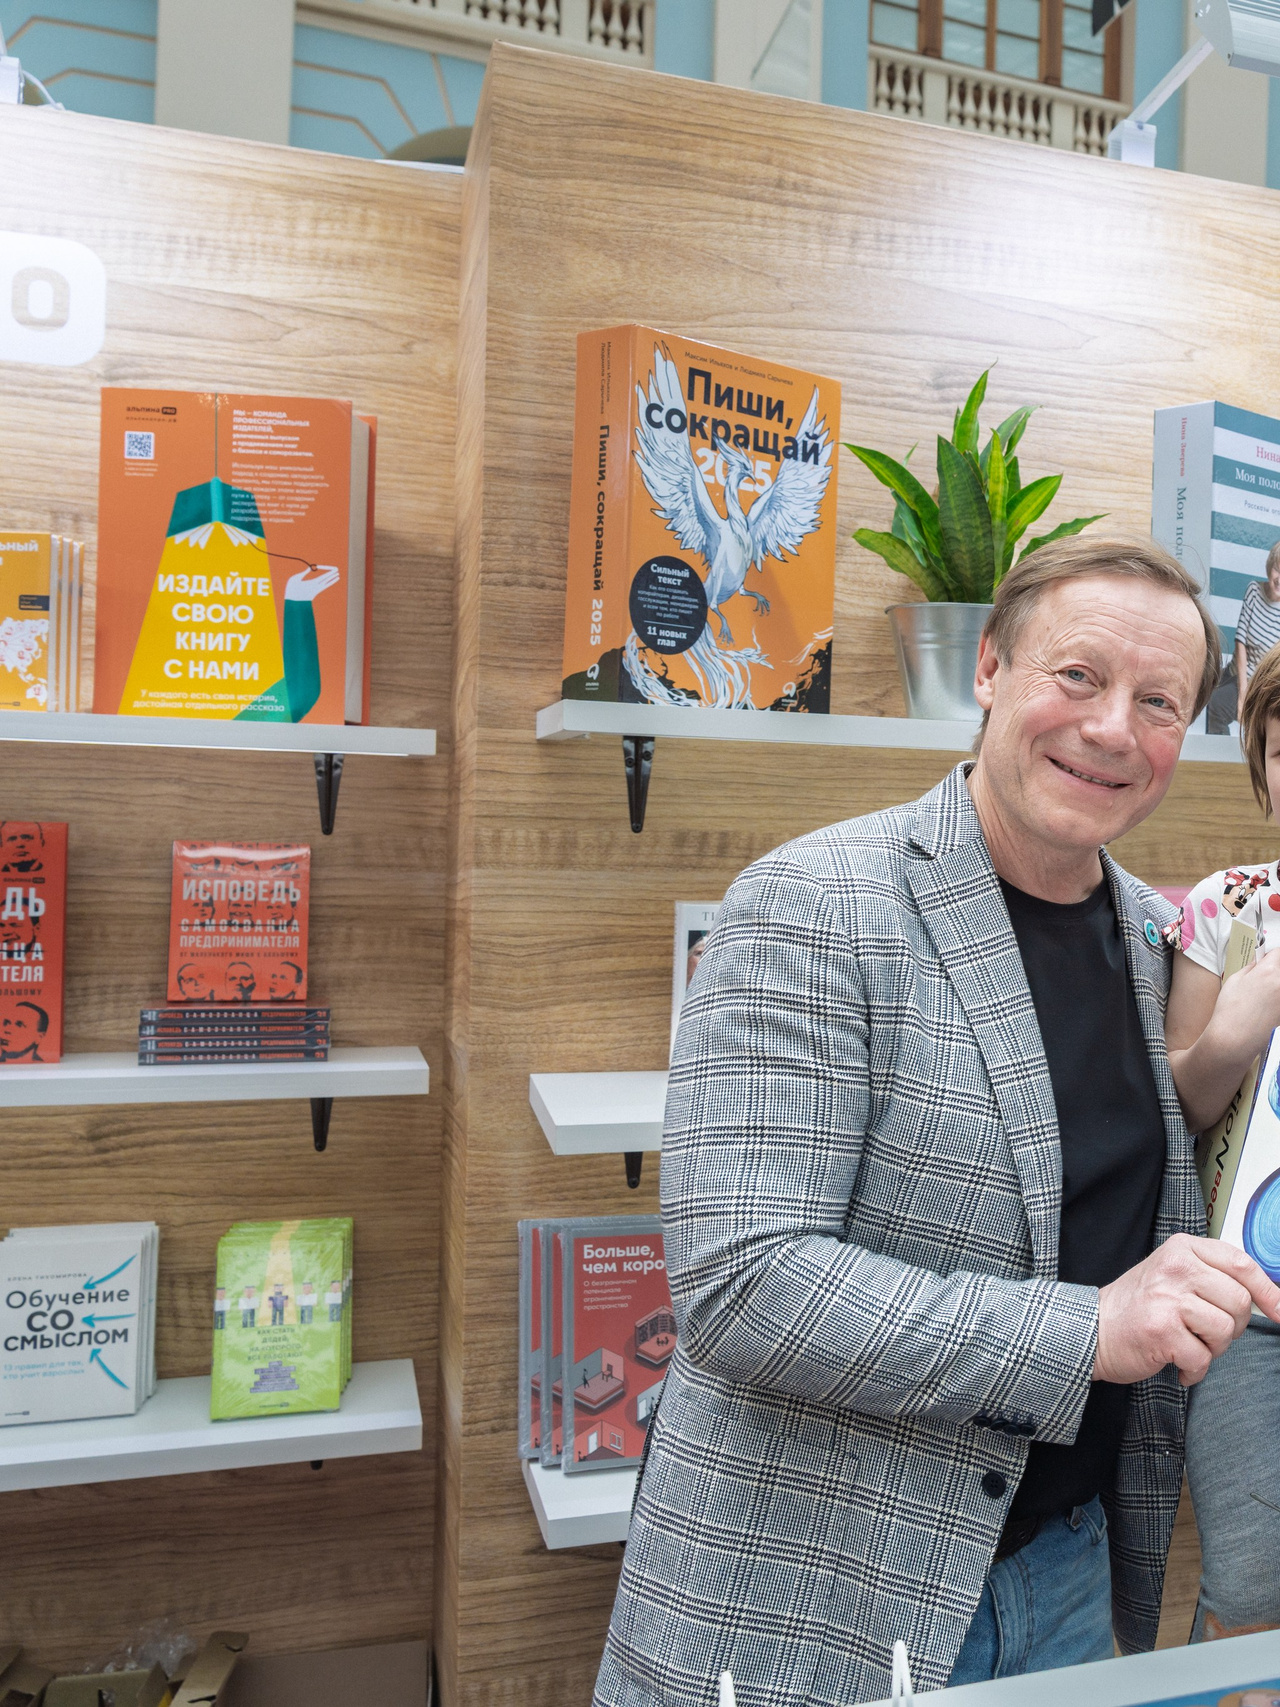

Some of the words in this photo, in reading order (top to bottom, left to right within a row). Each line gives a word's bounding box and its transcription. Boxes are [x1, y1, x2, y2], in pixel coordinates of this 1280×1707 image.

[684, 351, 708, 364] Максим
[740, 366, 766, 379] Людмила
[767, 373, 794, 386] Сарычева
[687, 366, 794, 430] Пиши,
[645, 402, 820, 466] сокращай
[596, 425, 610, 486] Пиши,
[1179, 443, 1187, 478] Зверева
[1256, 445, 1280, 463] Нина
[1235, 467, 1256, 483] Моя
[1176, 487, 1187, 520] Моя
[593, 491, 606, 591] сокращай
[650, 563, 690, 578] Сильный
[157, 571, 270, 597] ИЗДАЙТЕ
[657, 575, 682, 586] текст
[171, 602, 254, 624] СВОЮ
[590, 599, 603, 646] 2025
[175, 631, 251, 652] КНИГУ
[647, 626, 657, 635] 11
[659, 629, 687, 639] новых
[657, 638, 676, 647] глав
[163, 658, 183, 679] С
[188, 660, 259, 681] НАМИ
[140, 689, 148, 698] У
[190, 692, 211, 700] есть
[213, 693, 235, 701] своя
[182, 879, 301, 904] ИСПОВЕДЬ
[180, 918, 300, 934] САМОЗВАНЦА
[179, 935, 300, 948] ПРЕДПРИНИМАТЕЛЯ
[583, 1244, 655, 1259] Больше,
[582, 1262, 617, 1274] чем
[623, 1259, 665, 1275] коро
[583, 1287, 621, 1295] потенциале
[591, 1279, 637, 1287] безграничном
[6, 1289, 130, 1311] Обучение
[583, 1295, 632, 1303] ограниченного
[583, 1303, 629, 1311] пространства
